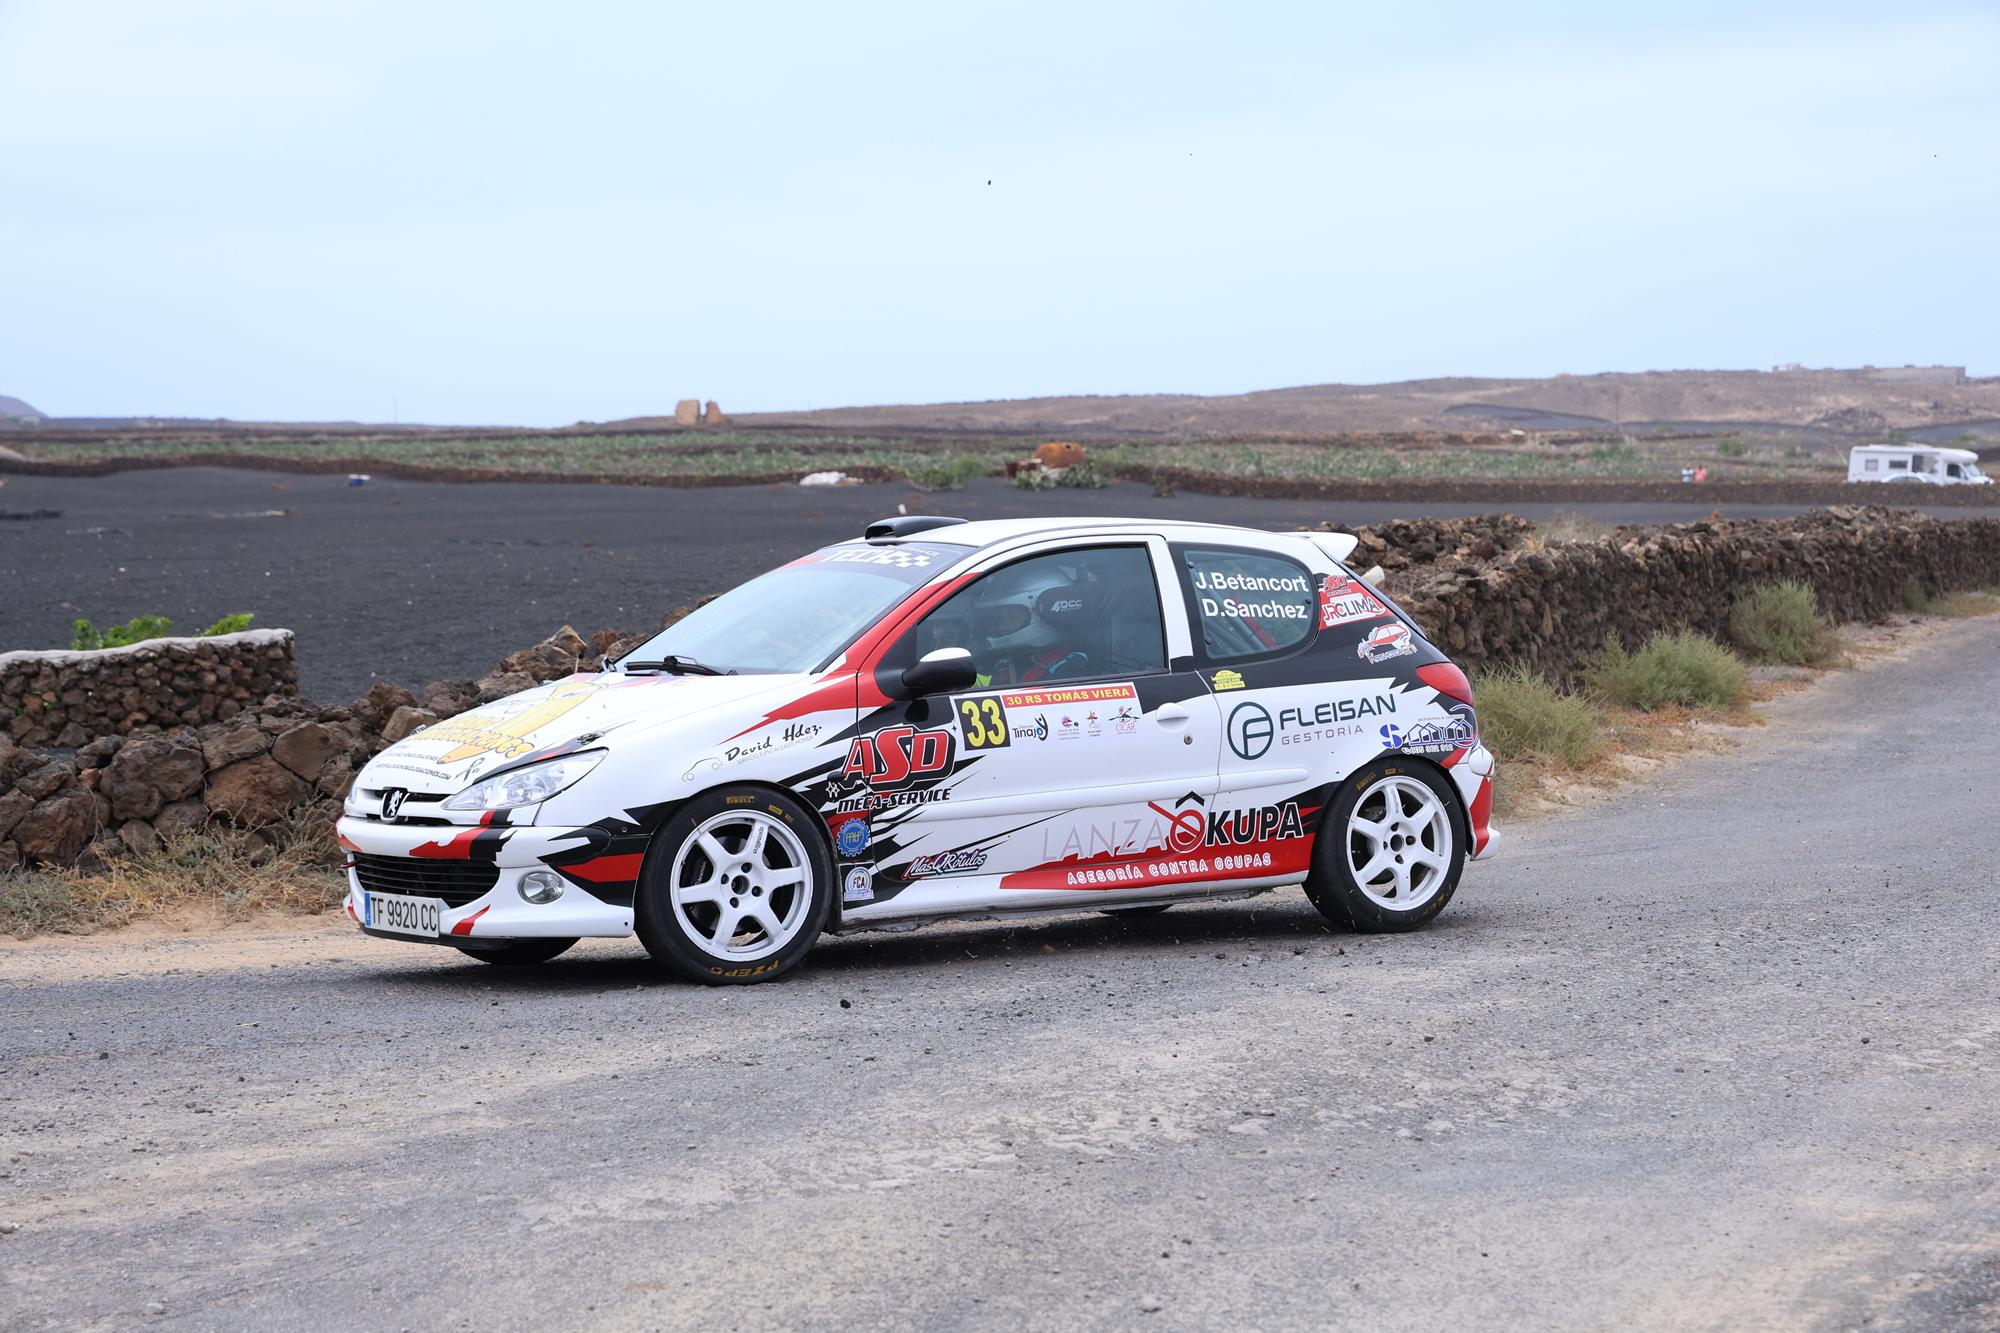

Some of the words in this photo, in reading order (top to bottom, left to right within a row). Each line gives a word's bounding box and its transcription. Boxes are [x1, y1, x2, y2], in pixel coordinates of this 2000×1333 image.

[1195, 572, 1310, 592] J.Betancort
[1201, 598, 1308, 619] D.Sanchez
[1007, 696, 1021, 706] 30
[1026, 695, 1041, 704] RS
[1044, 690, 1089, 702] TOMÁS
[1090, 688, 1130, 700] VIERA
[962, 698, 1006, 748] 33
[1279, 694, 1396, 730] FLEISAN
[1281, 725, 1364, 745] GESTORÍA
[725, 736, 773, 761] David
[842, 727, 950, 785] ASD
[836, 788, 952, 814] MECA-SERVICE
[1043, 816, 1168, 861] LANZA
[852, 875, 867, 889] FCA
[1067, 864, 1144, 885] ASESORÍA
[1150, 859, 1210, 878] CONTRA
[1214, 853, 1272, 871] OCUPAS
[371, 896, 384, 925] TF
[387, 899, 417, 930] 9920
[420, 903, 437, 931] CC
